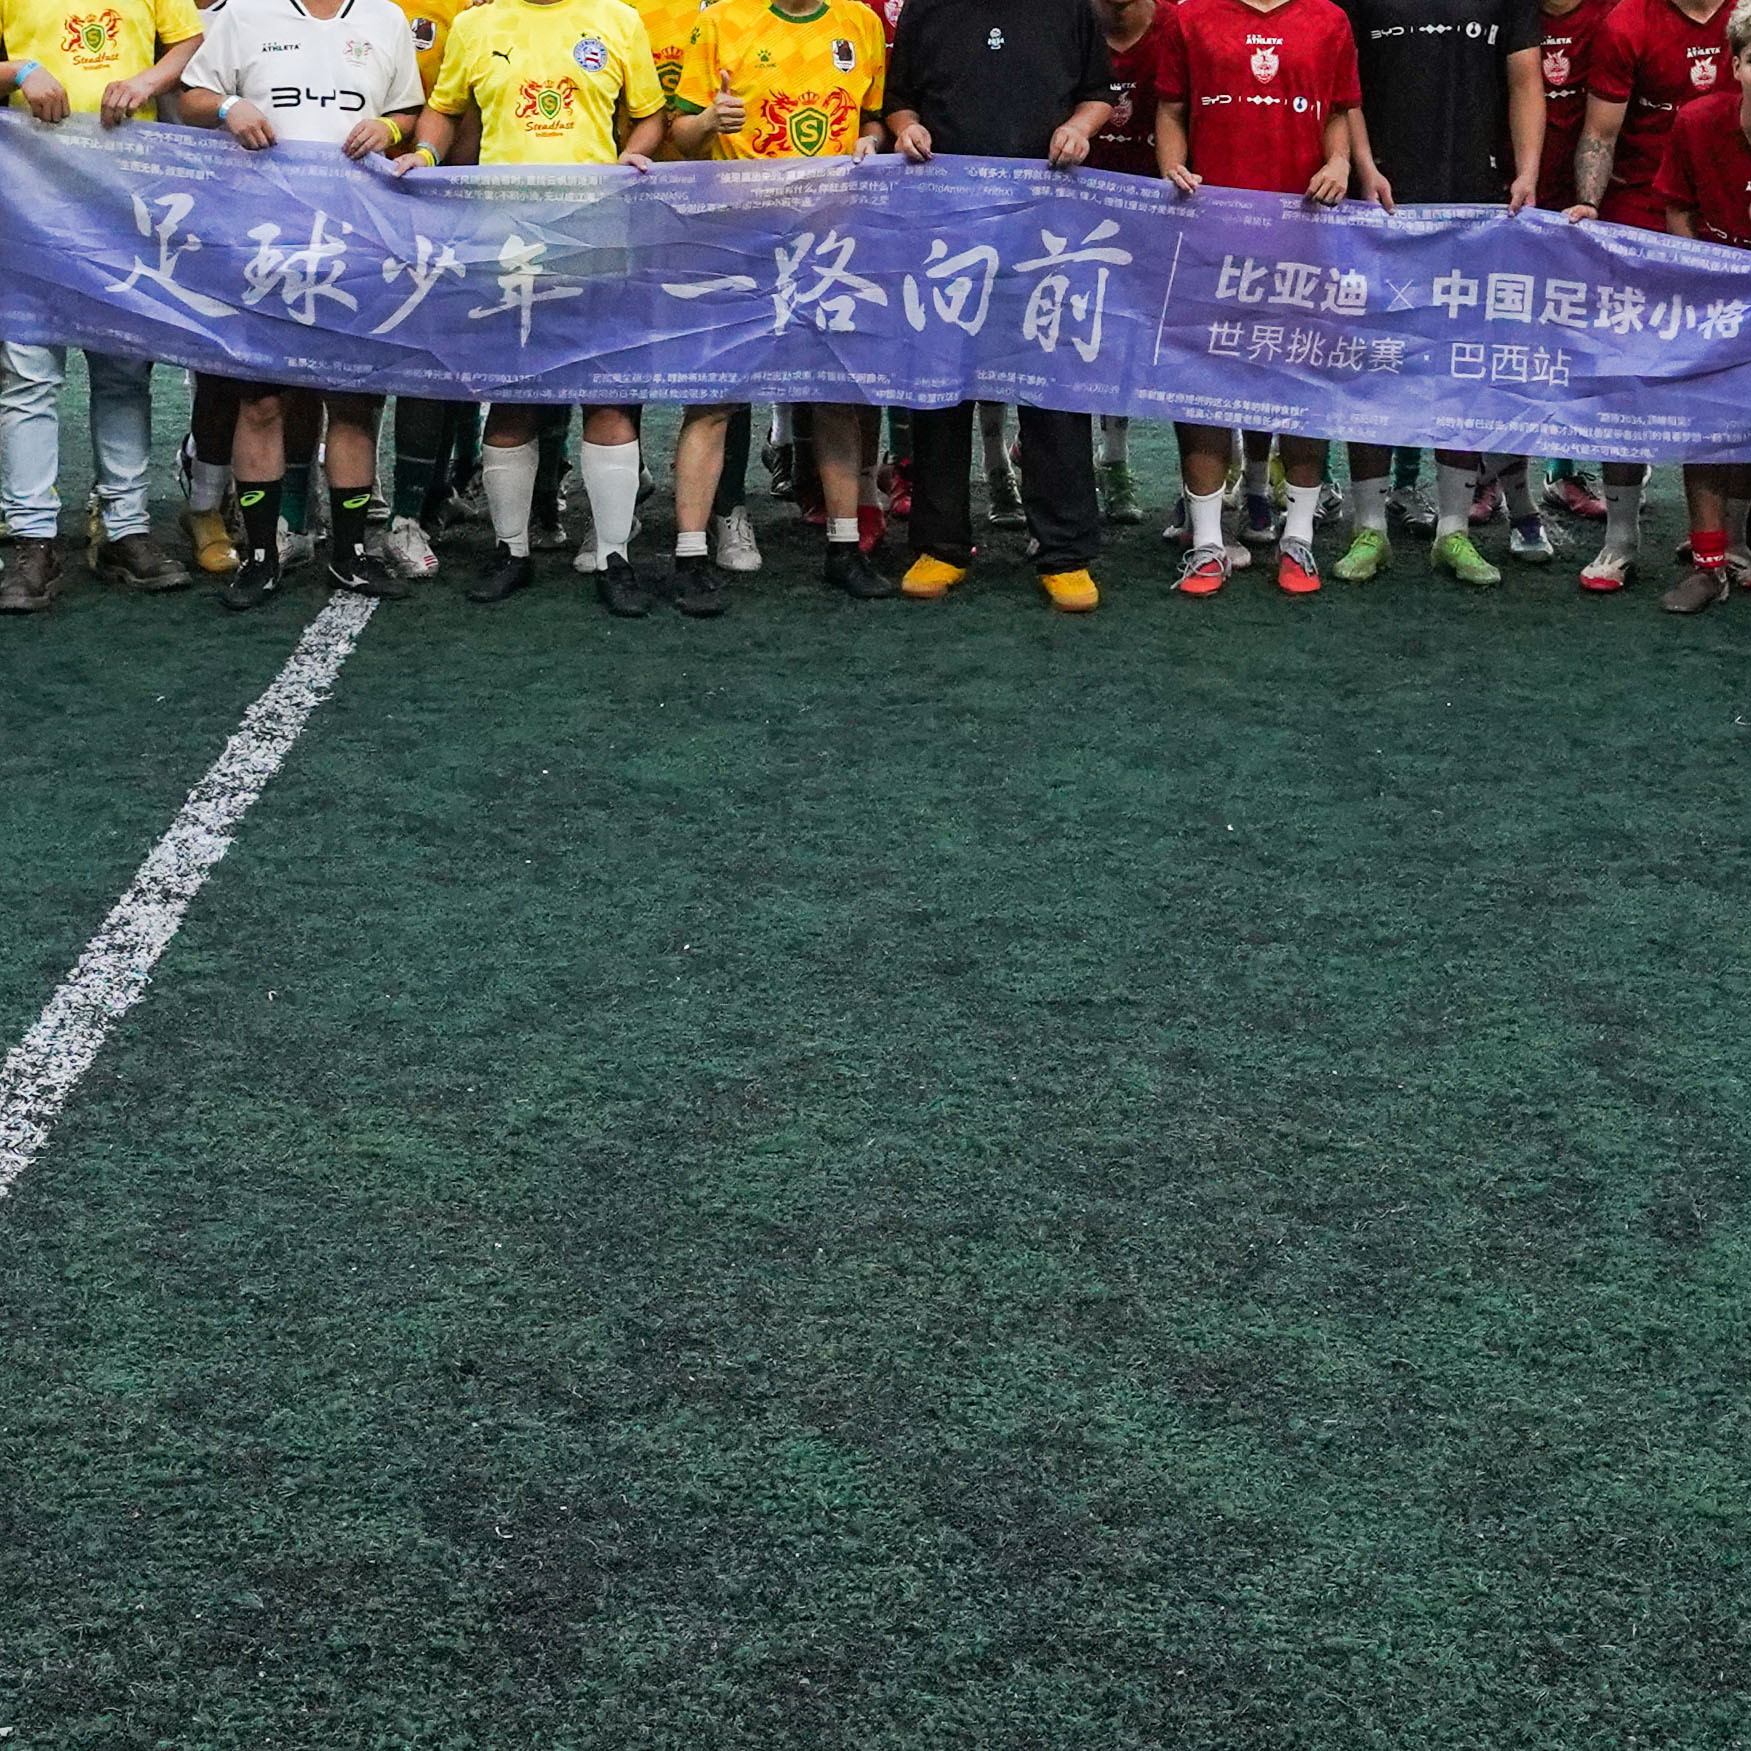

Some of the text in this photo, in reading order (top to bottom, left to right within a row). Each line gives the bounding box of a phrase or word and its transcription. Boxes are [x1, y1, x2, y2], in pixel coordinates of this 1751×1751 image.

[1370, 26, 1405, 39] BYD
[271, 86, 366, 112] BYD
[1201, 94, 1232, 106] BYD
[525, 121, 575, 133] Steadfast
[800, 119, 819, 142] S
[105, 192, 1134, 363] 足球少年 一路向前
[1214, 254, 1369, 316] 比亚迪
[1433, 268, 1750, 341] 中国足球小将
[1208, 321, 1406, 374] 世界挑战赛
[1450, 342, 1571, 386] 巴西站
